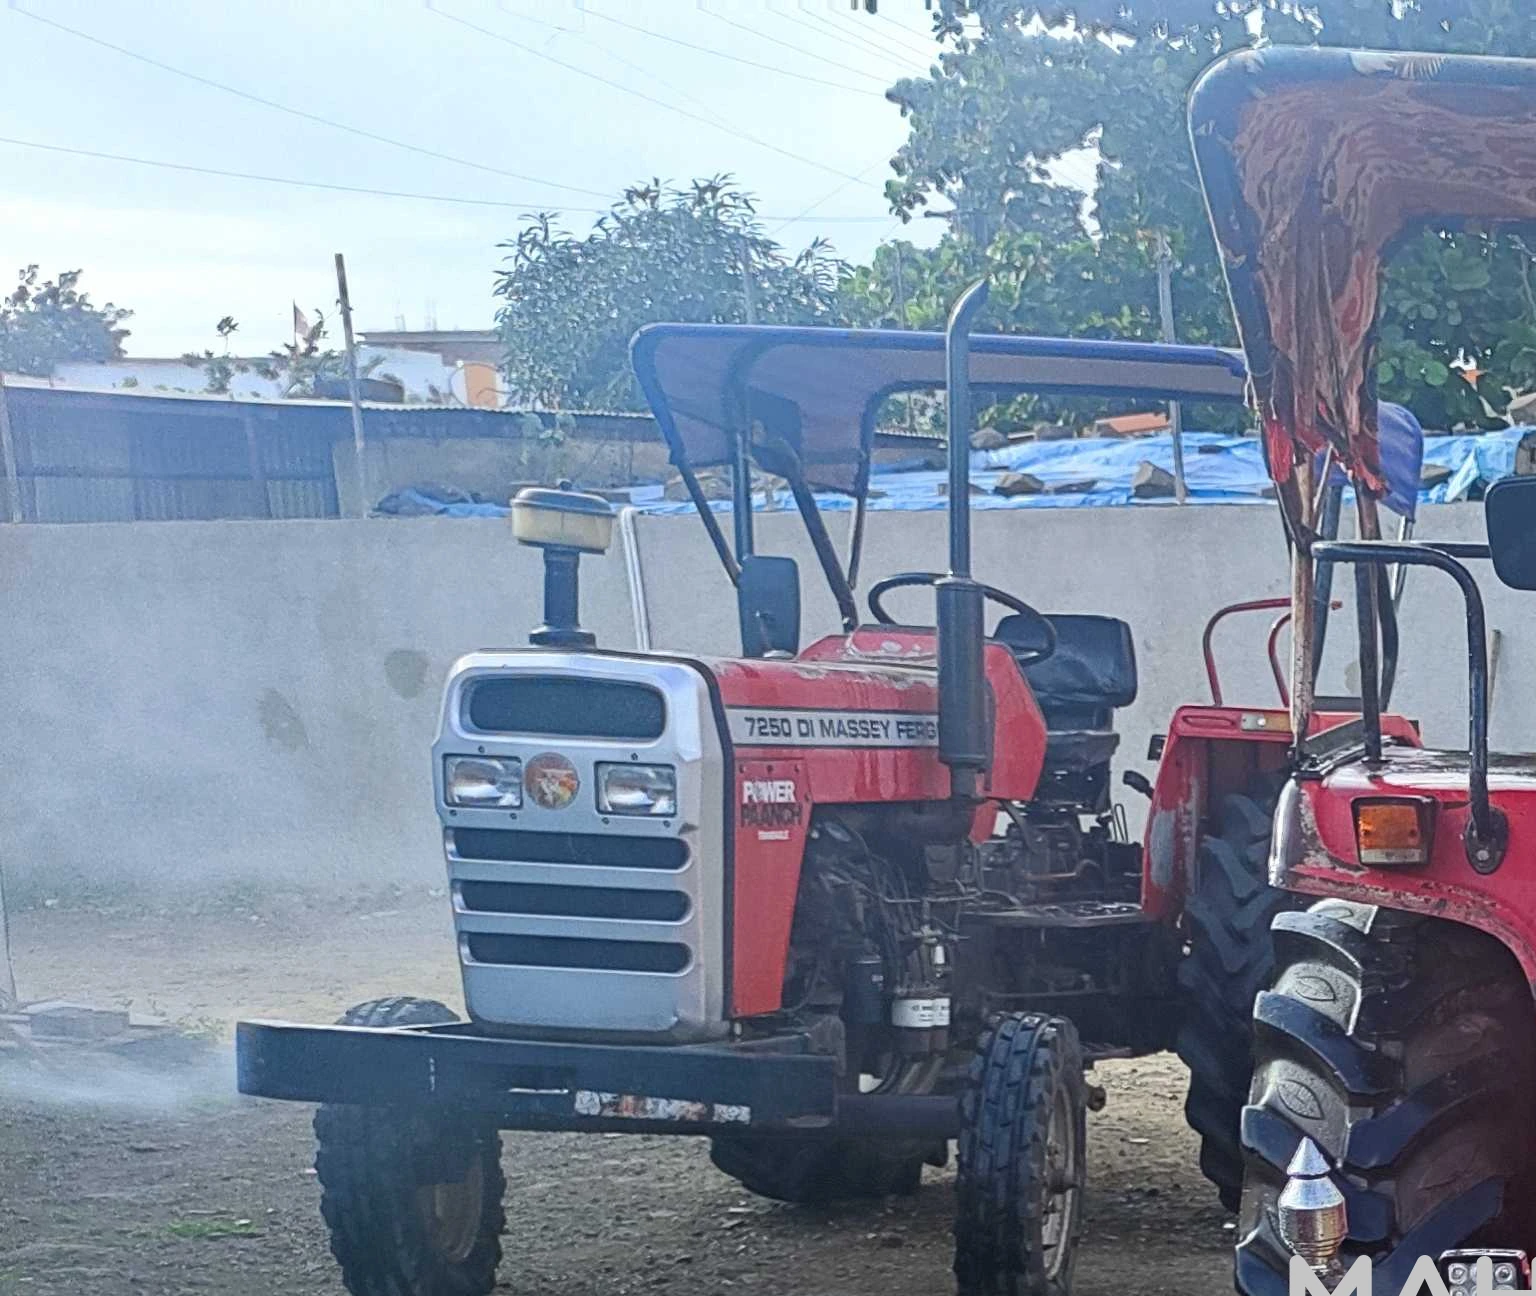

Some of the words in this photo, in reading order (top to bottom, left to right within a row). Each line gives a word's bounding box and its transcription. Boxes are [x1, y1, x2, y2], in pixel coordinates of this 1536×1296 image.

[744, 717, 792, 737] 7250
[797, 720, 815, 737] DI
[820, 719, 890, 739] MASSEY
[896, 721, 939, 739] FERG
